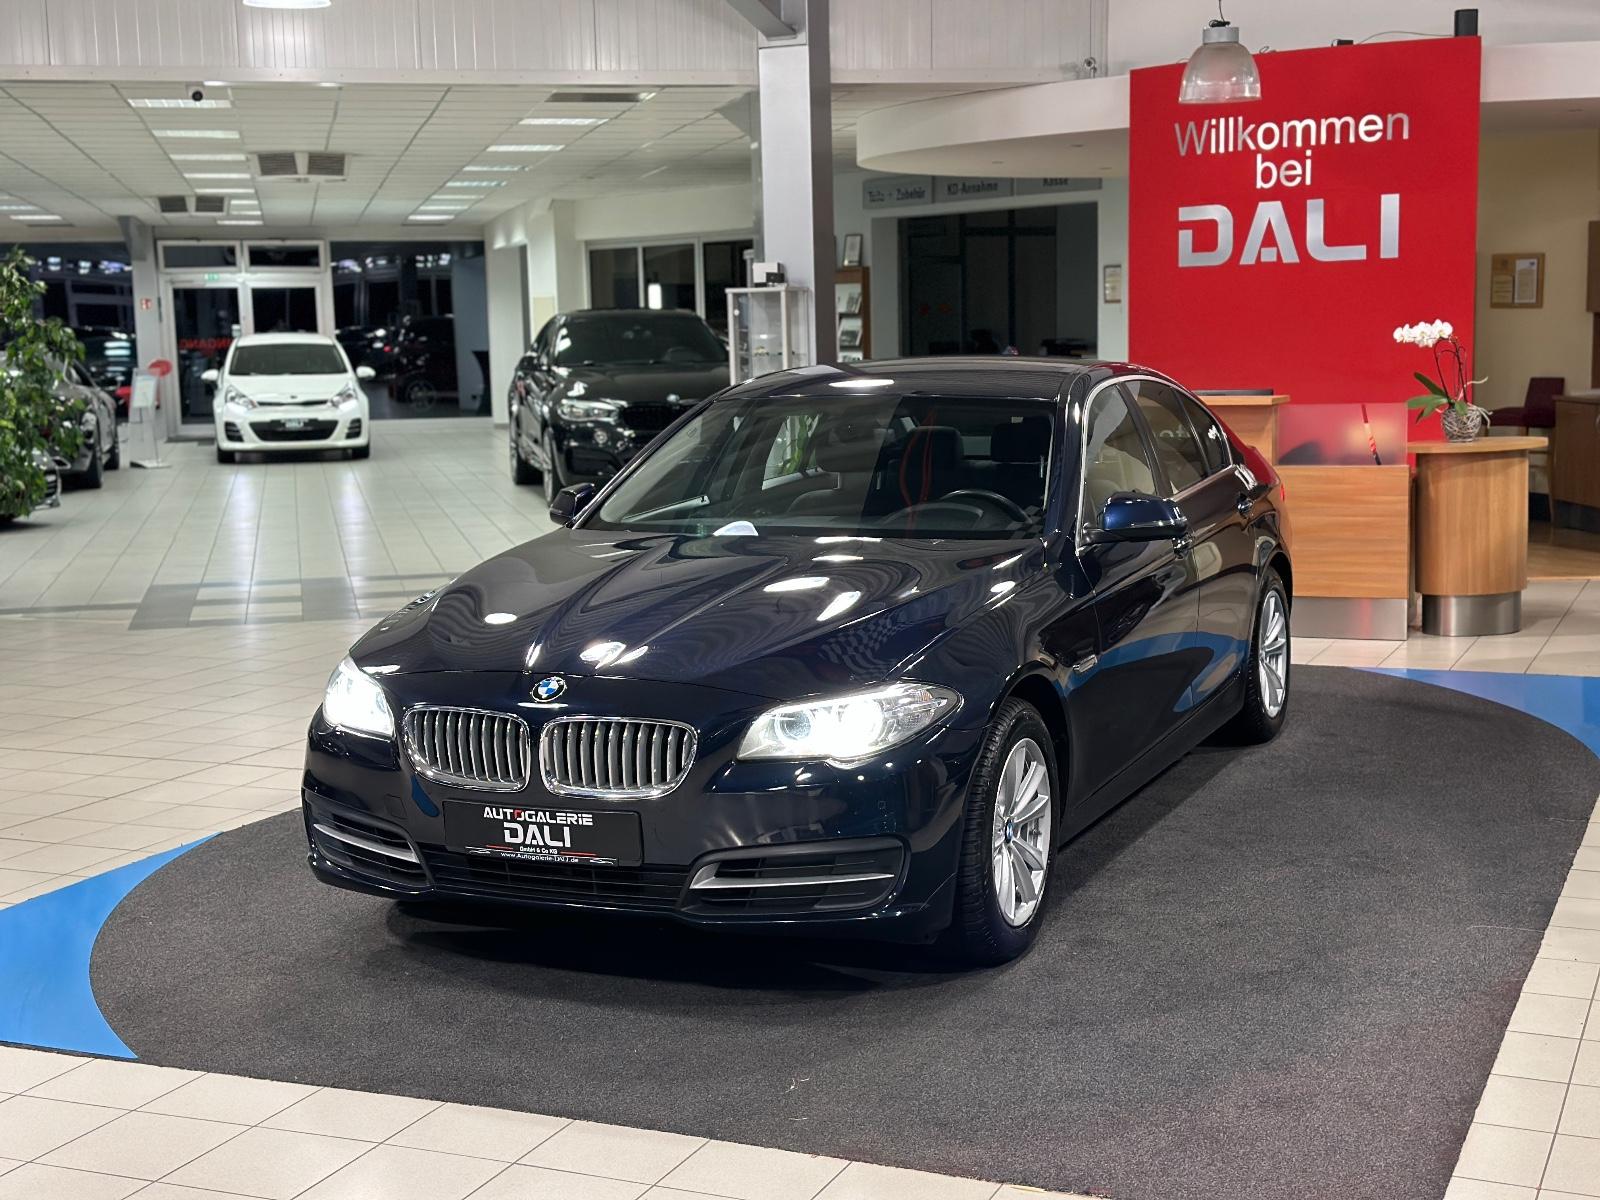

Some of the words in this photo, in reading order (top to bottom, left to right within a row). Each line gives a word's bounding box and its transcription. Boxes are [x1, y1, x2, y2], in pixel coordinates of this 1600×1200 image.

[1174, 112, 1409, 156] Willkommen
[1256, 149, 1312, 189] bei
[1178, 193, 1400, 268] DALI
[483, 807, 593, 825] AUTOGALERIE
[503, 822, 571, 847] DALI
[520, 845, 536, 853] GmbH
[549, 847, 558, 855] KG
